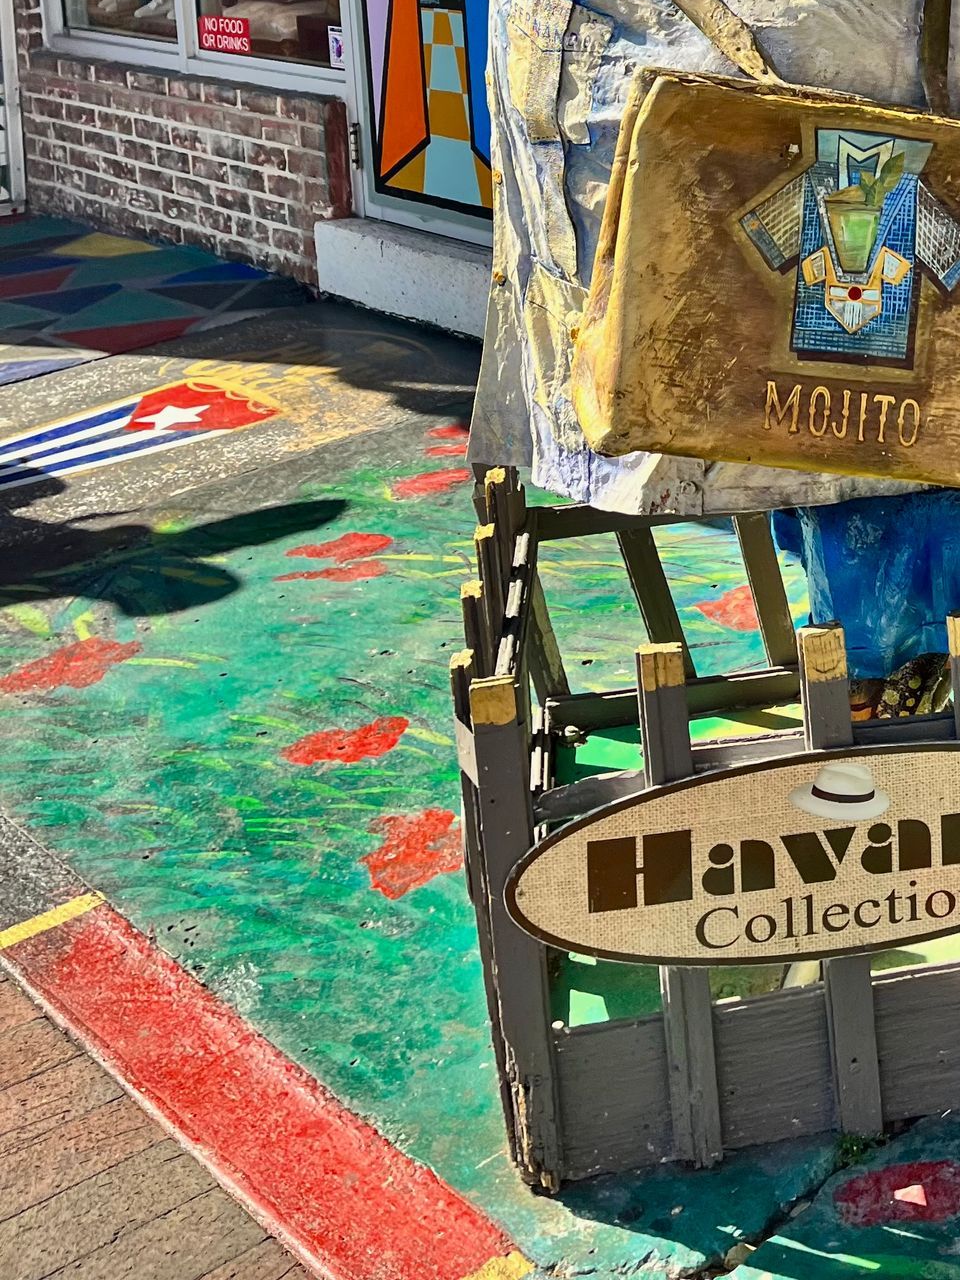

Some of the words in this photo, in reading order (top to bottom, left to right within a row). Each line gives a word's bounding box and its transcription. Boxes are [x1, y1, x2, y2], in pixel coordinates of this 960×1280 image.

[204, 18, 218, 31] NO
[219, 19, 244, 34] FOOD
[202, 33, 216, 47] OR
[217, 35, 249, 52] DRINKS
[761, 380, 921, 447] MOJITO
